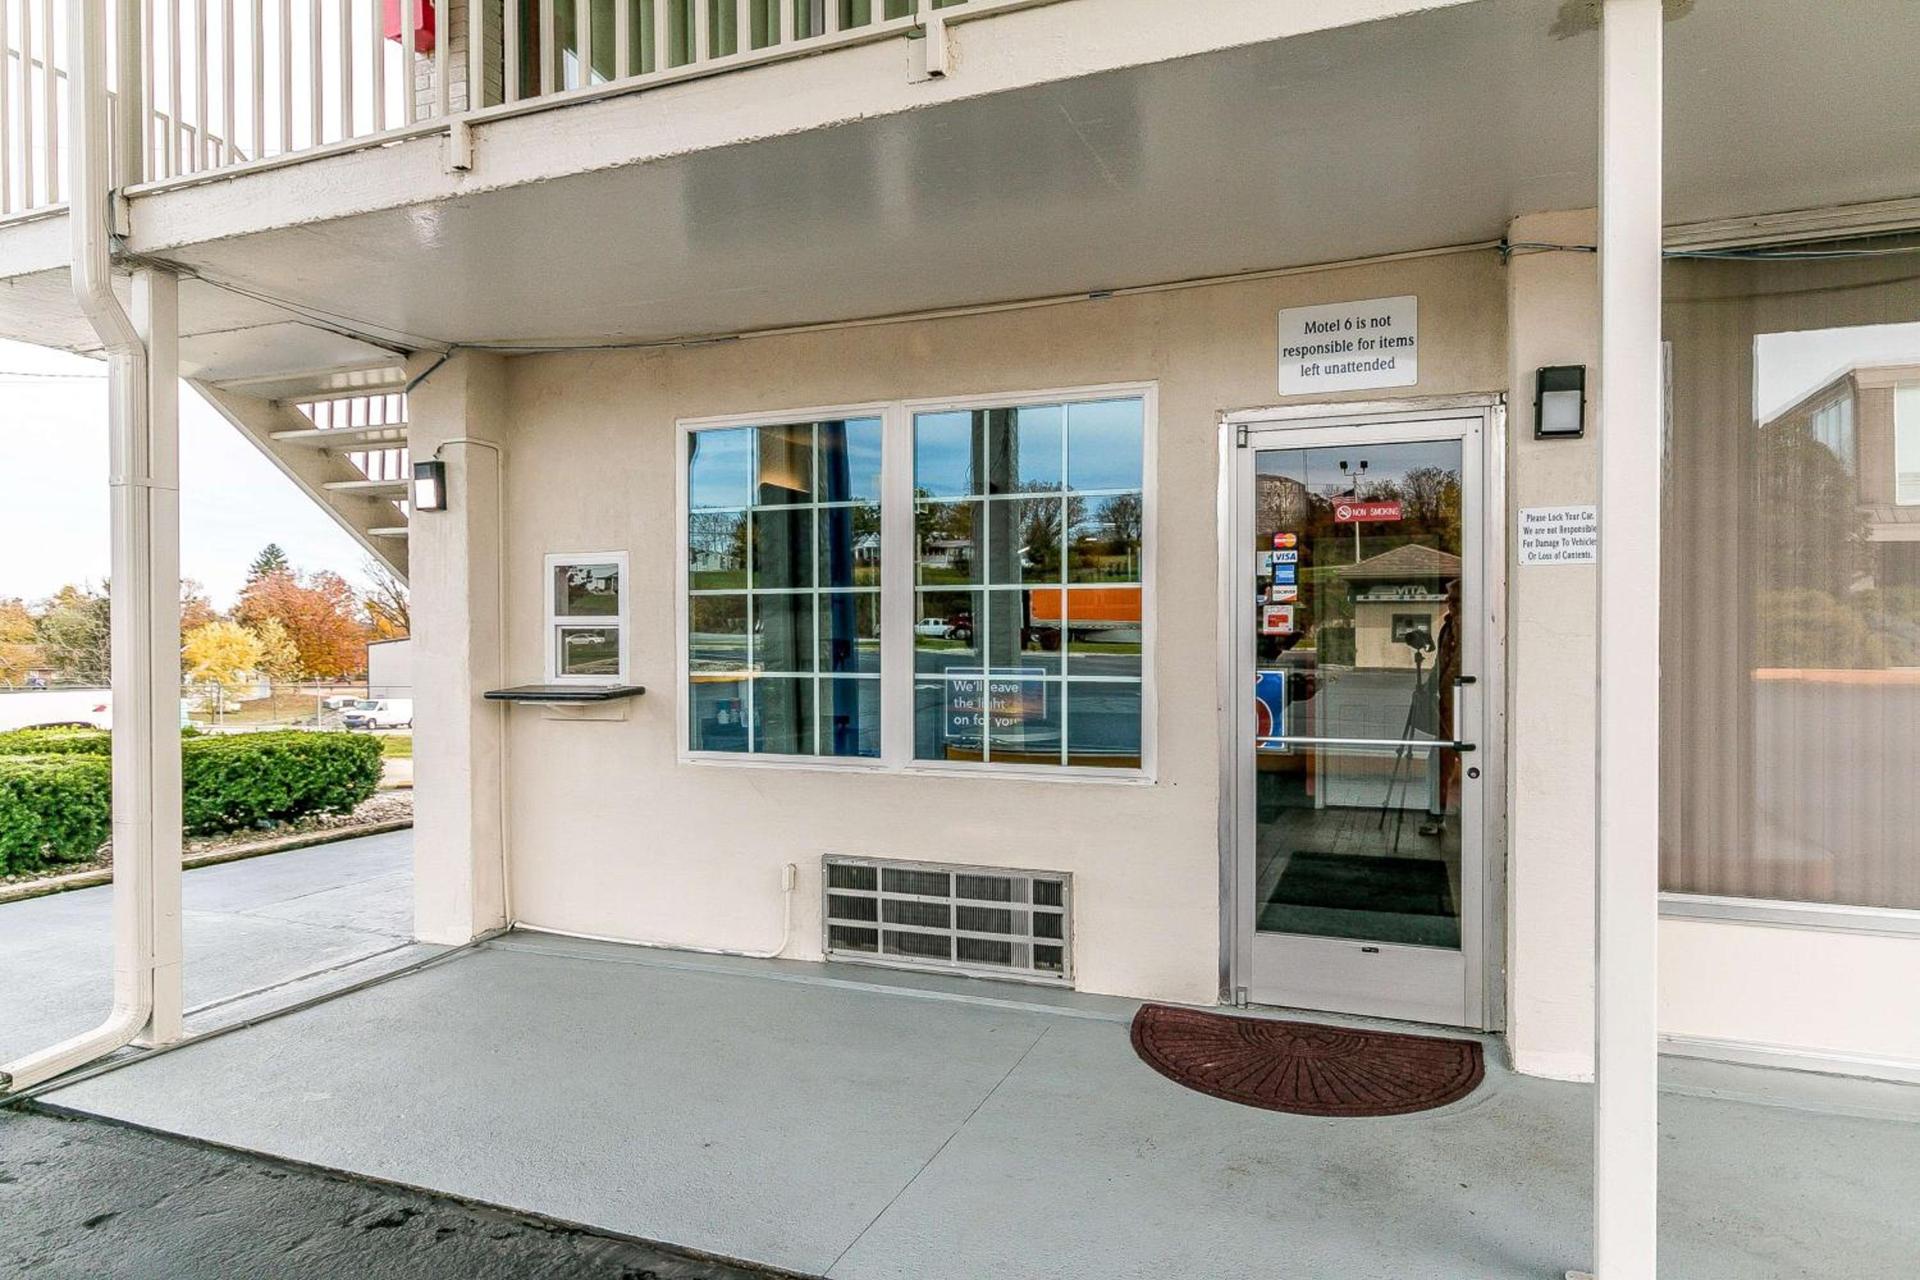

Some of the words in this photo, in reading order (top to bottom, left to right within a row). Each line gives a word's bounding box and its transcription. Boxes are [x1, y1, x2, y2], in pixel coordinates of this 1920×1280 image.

[1304, 320, 1340, 335] Motel
[1344, 318, 1352, 331] 6
[1356, 317, 1366, 329] is
[1371, 315, 1391, 328] not
[1283, 340, 1354, 359] responsible
[1358, 338, 1376, 351] for
[1379, 335, 1414, 349] items
[1301, 363, 1320, 377] left
[1325, 356, 1395, 375] unattended
[1370, 507, 1399, 516] SMOKING
[1526, 513, 1547, 522] Please
[1548, 512, 1563, 522] Lock
[1565, 512, 1580, 521] Your
[1523, 527, 1533, 535] We
[1535, 527, 1545, 535] are
[1547, 526, 1557, 534] not
[1523, 539, 1533, 548] For
[1535, 538, 1559, 549] Damage
[1562, 537, 1570, 547] To
[1275, 552, 1296, 561] VISA
[1528, 551, 1536, 560] Or
[1538, 551, 1552, 560] Loss
[1554, 551, 1561, 560] of
[953, 680, 982, 692] We'll
[988, 683, 1018, 692] eave
[954, 697, 973, 708] the
[979, 697, 1005, 709] liht
[954, 716, 969, 725] on
[974, 713, 988, 725] fo
